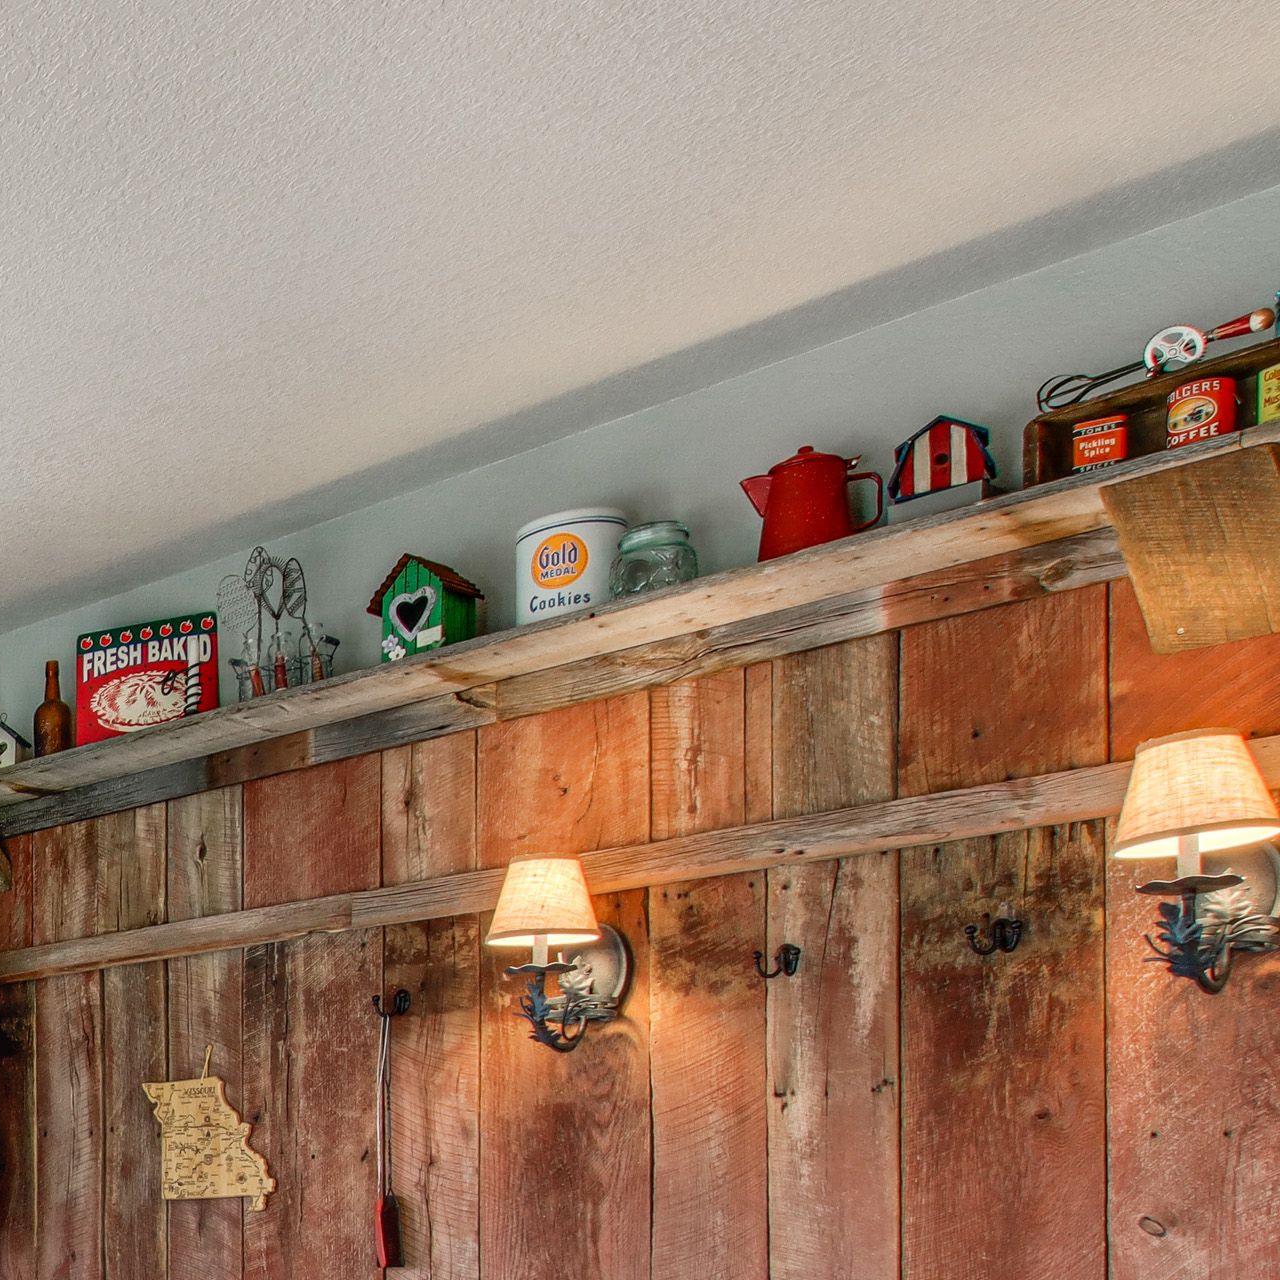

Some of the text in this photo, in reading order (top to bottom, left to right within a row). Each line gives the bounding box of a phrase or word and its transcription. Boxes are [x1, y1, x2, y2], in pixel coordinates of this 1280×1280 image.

[1079, 438, 1116, 450] Pickling
[1166, 422, 1220, 449] COFFEE
[1084, 447, 1110, 458] Spice
[538, 542, 578, 569] Gold
[540, 567, 577, 580] MEDAL
[529, 591, 591, 613] Cookies
[82, 633, 212, 683] FRESH BAKD
